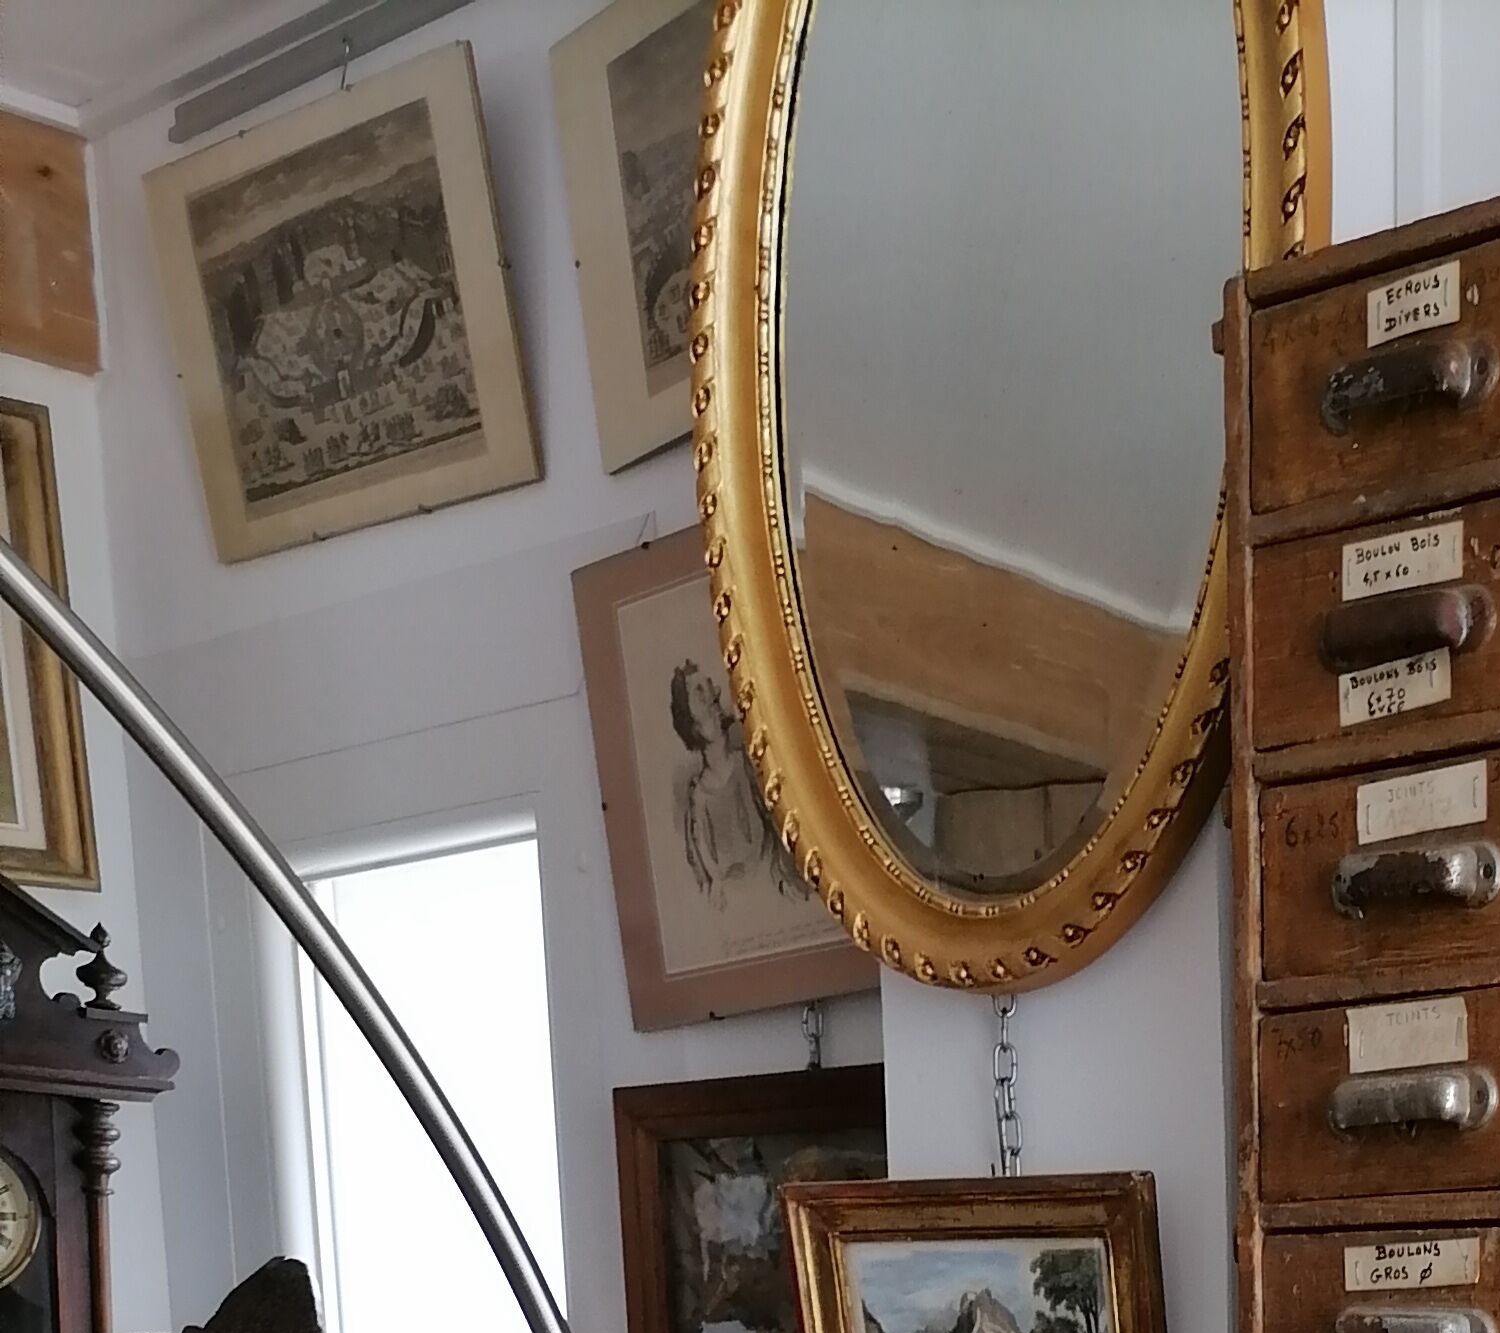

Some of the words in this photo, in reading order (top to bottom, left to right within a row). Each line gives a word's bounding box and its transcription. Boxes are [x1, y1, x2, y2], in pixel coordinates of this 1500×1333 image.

[1386, 274, 1441, 305] ECROUS
[1384, 304, 1441, 334] DIVERS
[1374, 1242, 1441, 1261] BOULONS
[1369, 1266, 1409, 1285] GROS
